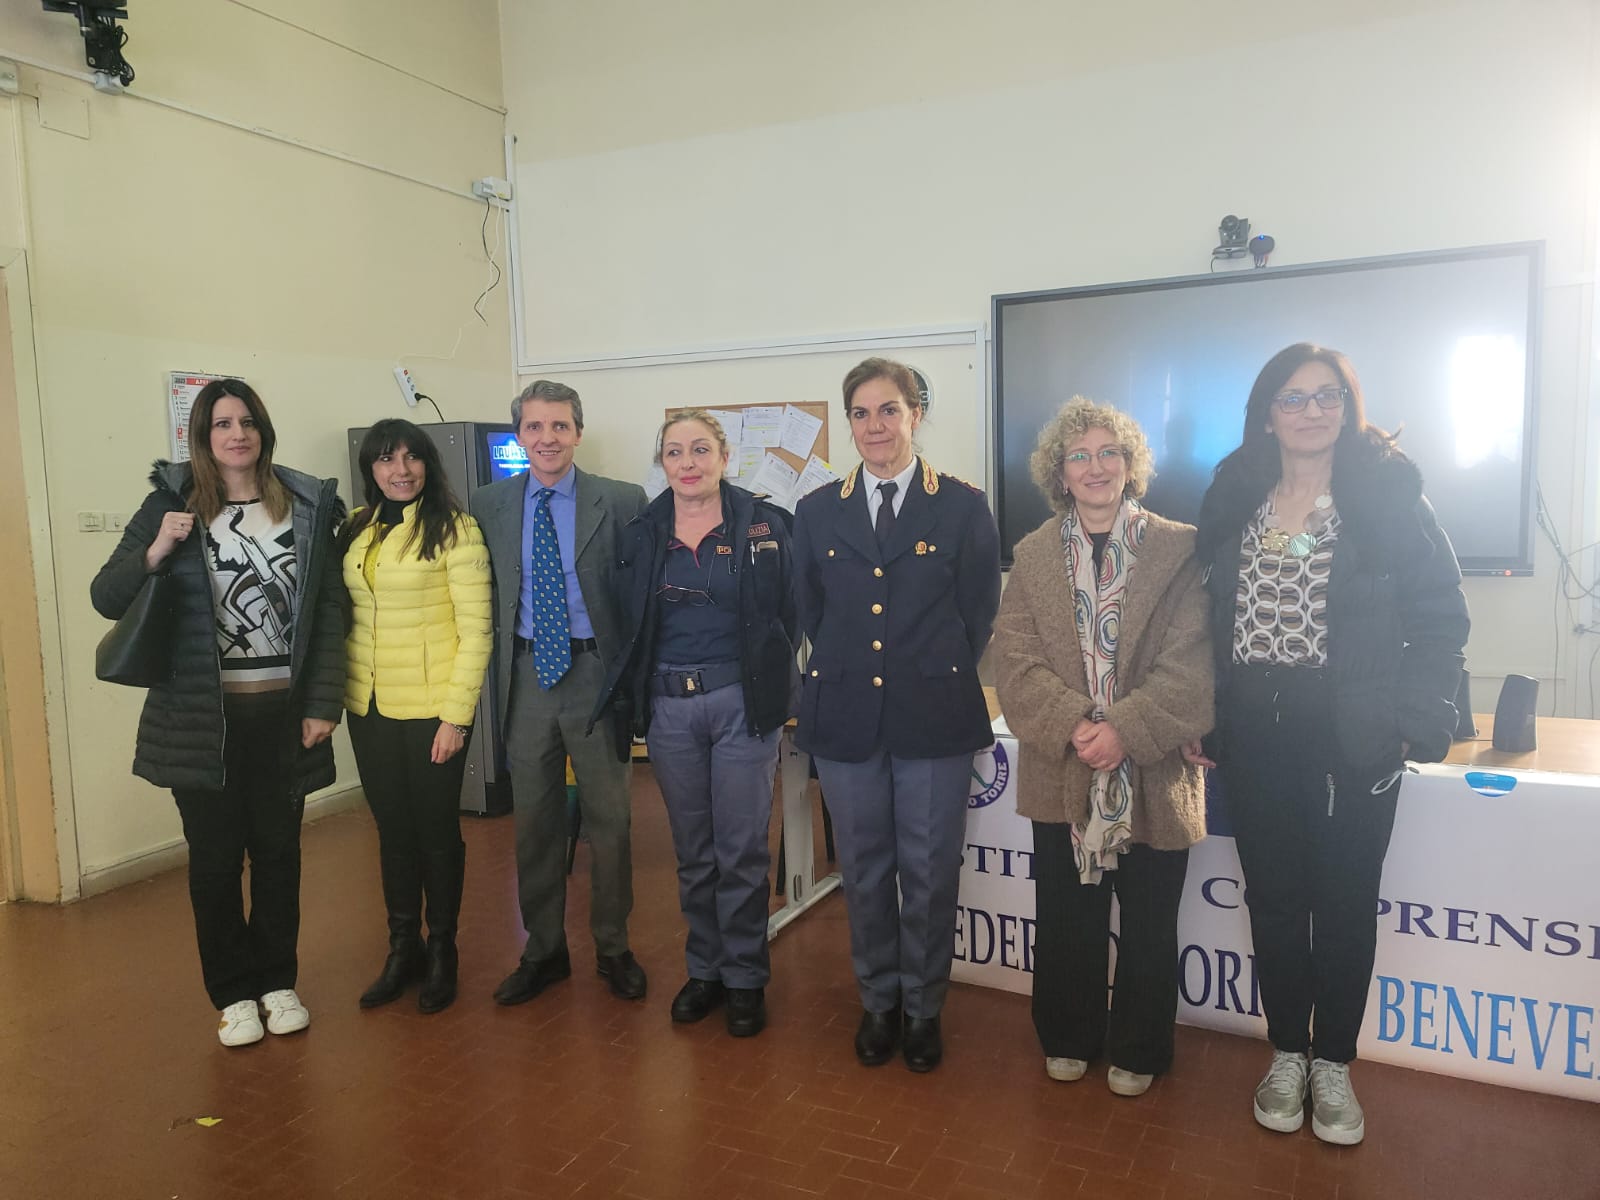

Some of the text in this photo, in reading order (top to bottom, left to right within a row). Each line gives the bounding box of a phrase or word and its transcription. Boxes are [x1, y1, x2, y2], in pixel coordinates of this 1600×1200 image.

[748, 525, 769, 536] OLIZIA
[980, 761, 1007, 803] TORRE
[1376, 975, 1600, 1081] BENEVE
